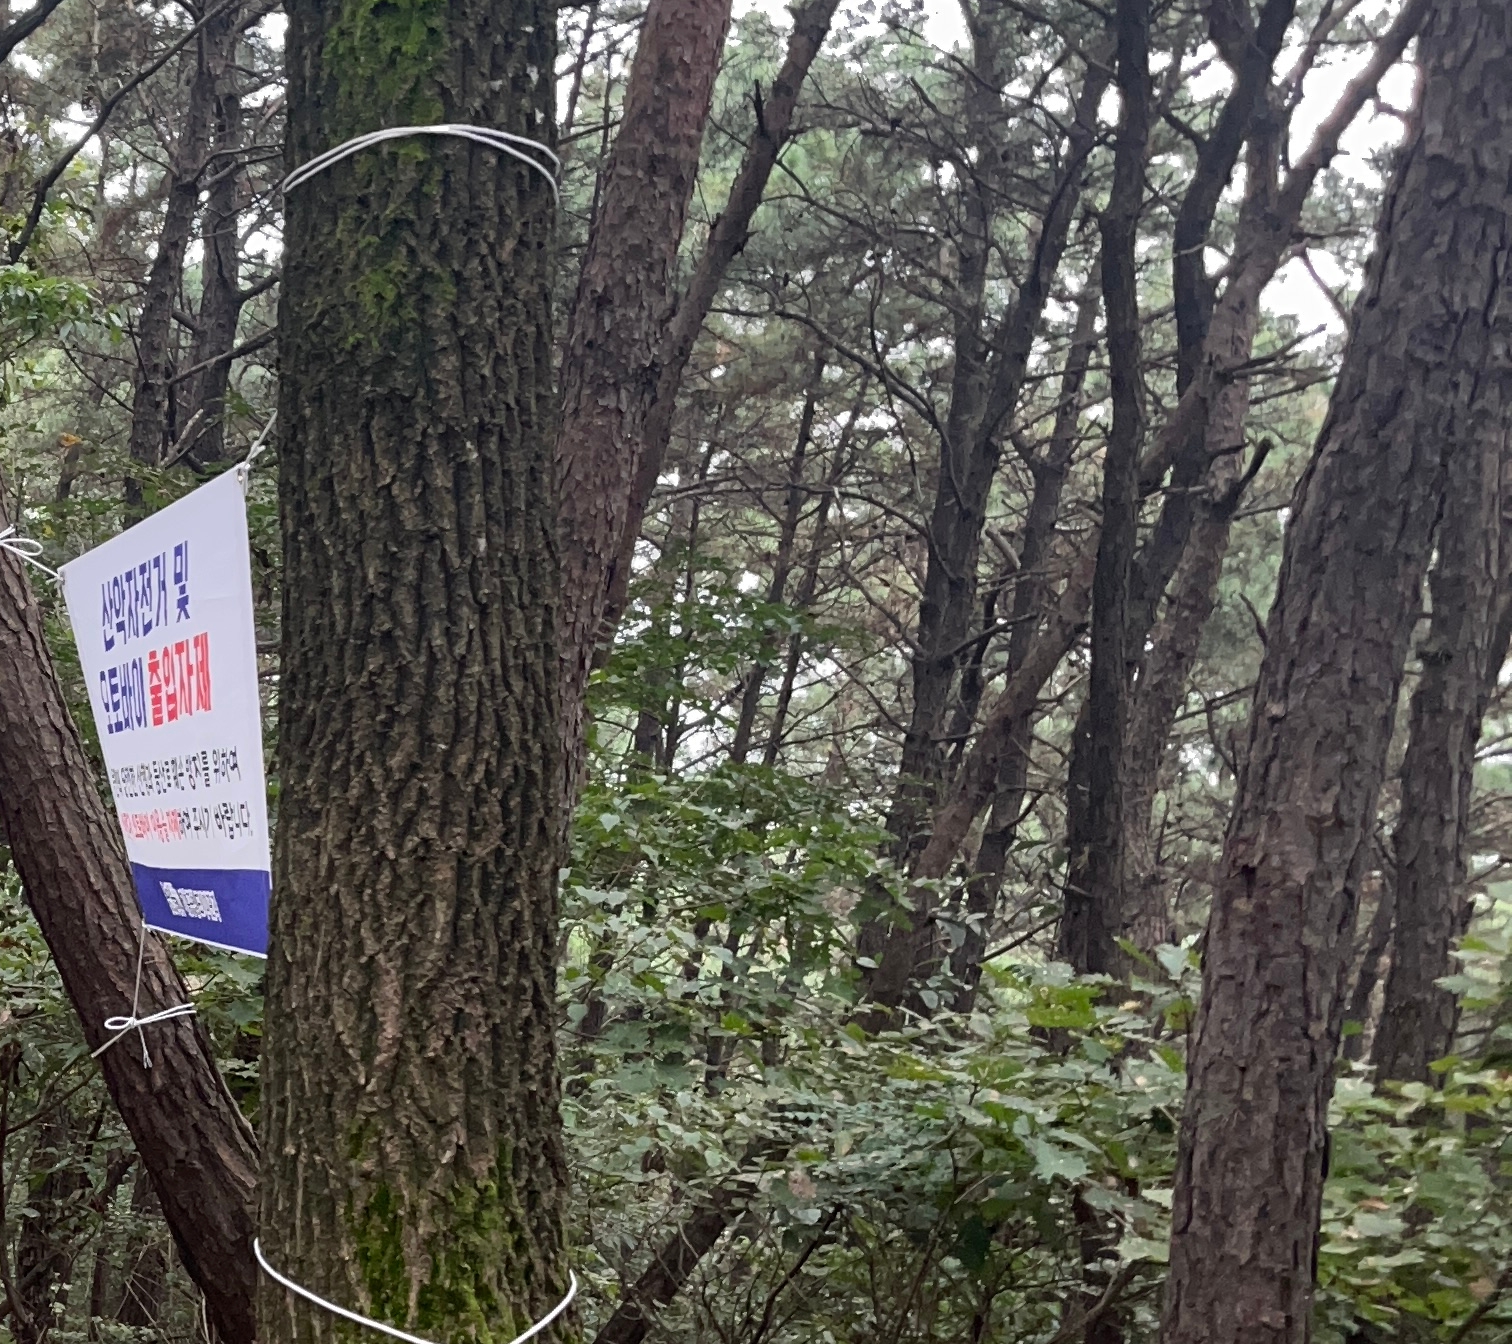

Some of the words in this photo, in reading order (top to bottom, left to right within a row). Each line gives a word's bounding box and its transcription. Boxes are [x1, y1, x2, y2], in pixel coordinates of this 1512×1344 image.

[101, 551, 168, 653] 산악자전거
[173, 540, 191, 624] 및
[99, 656, 148, 735] 오토바이
[147, 631, 212, 728] 출입자제
[185, 749, 211, 791] 방지를
[212, 746, 241, 783] 위하여
[192, 805, 216, 841] 주시기
[215, 801, 254, 841] 바랍니다.
